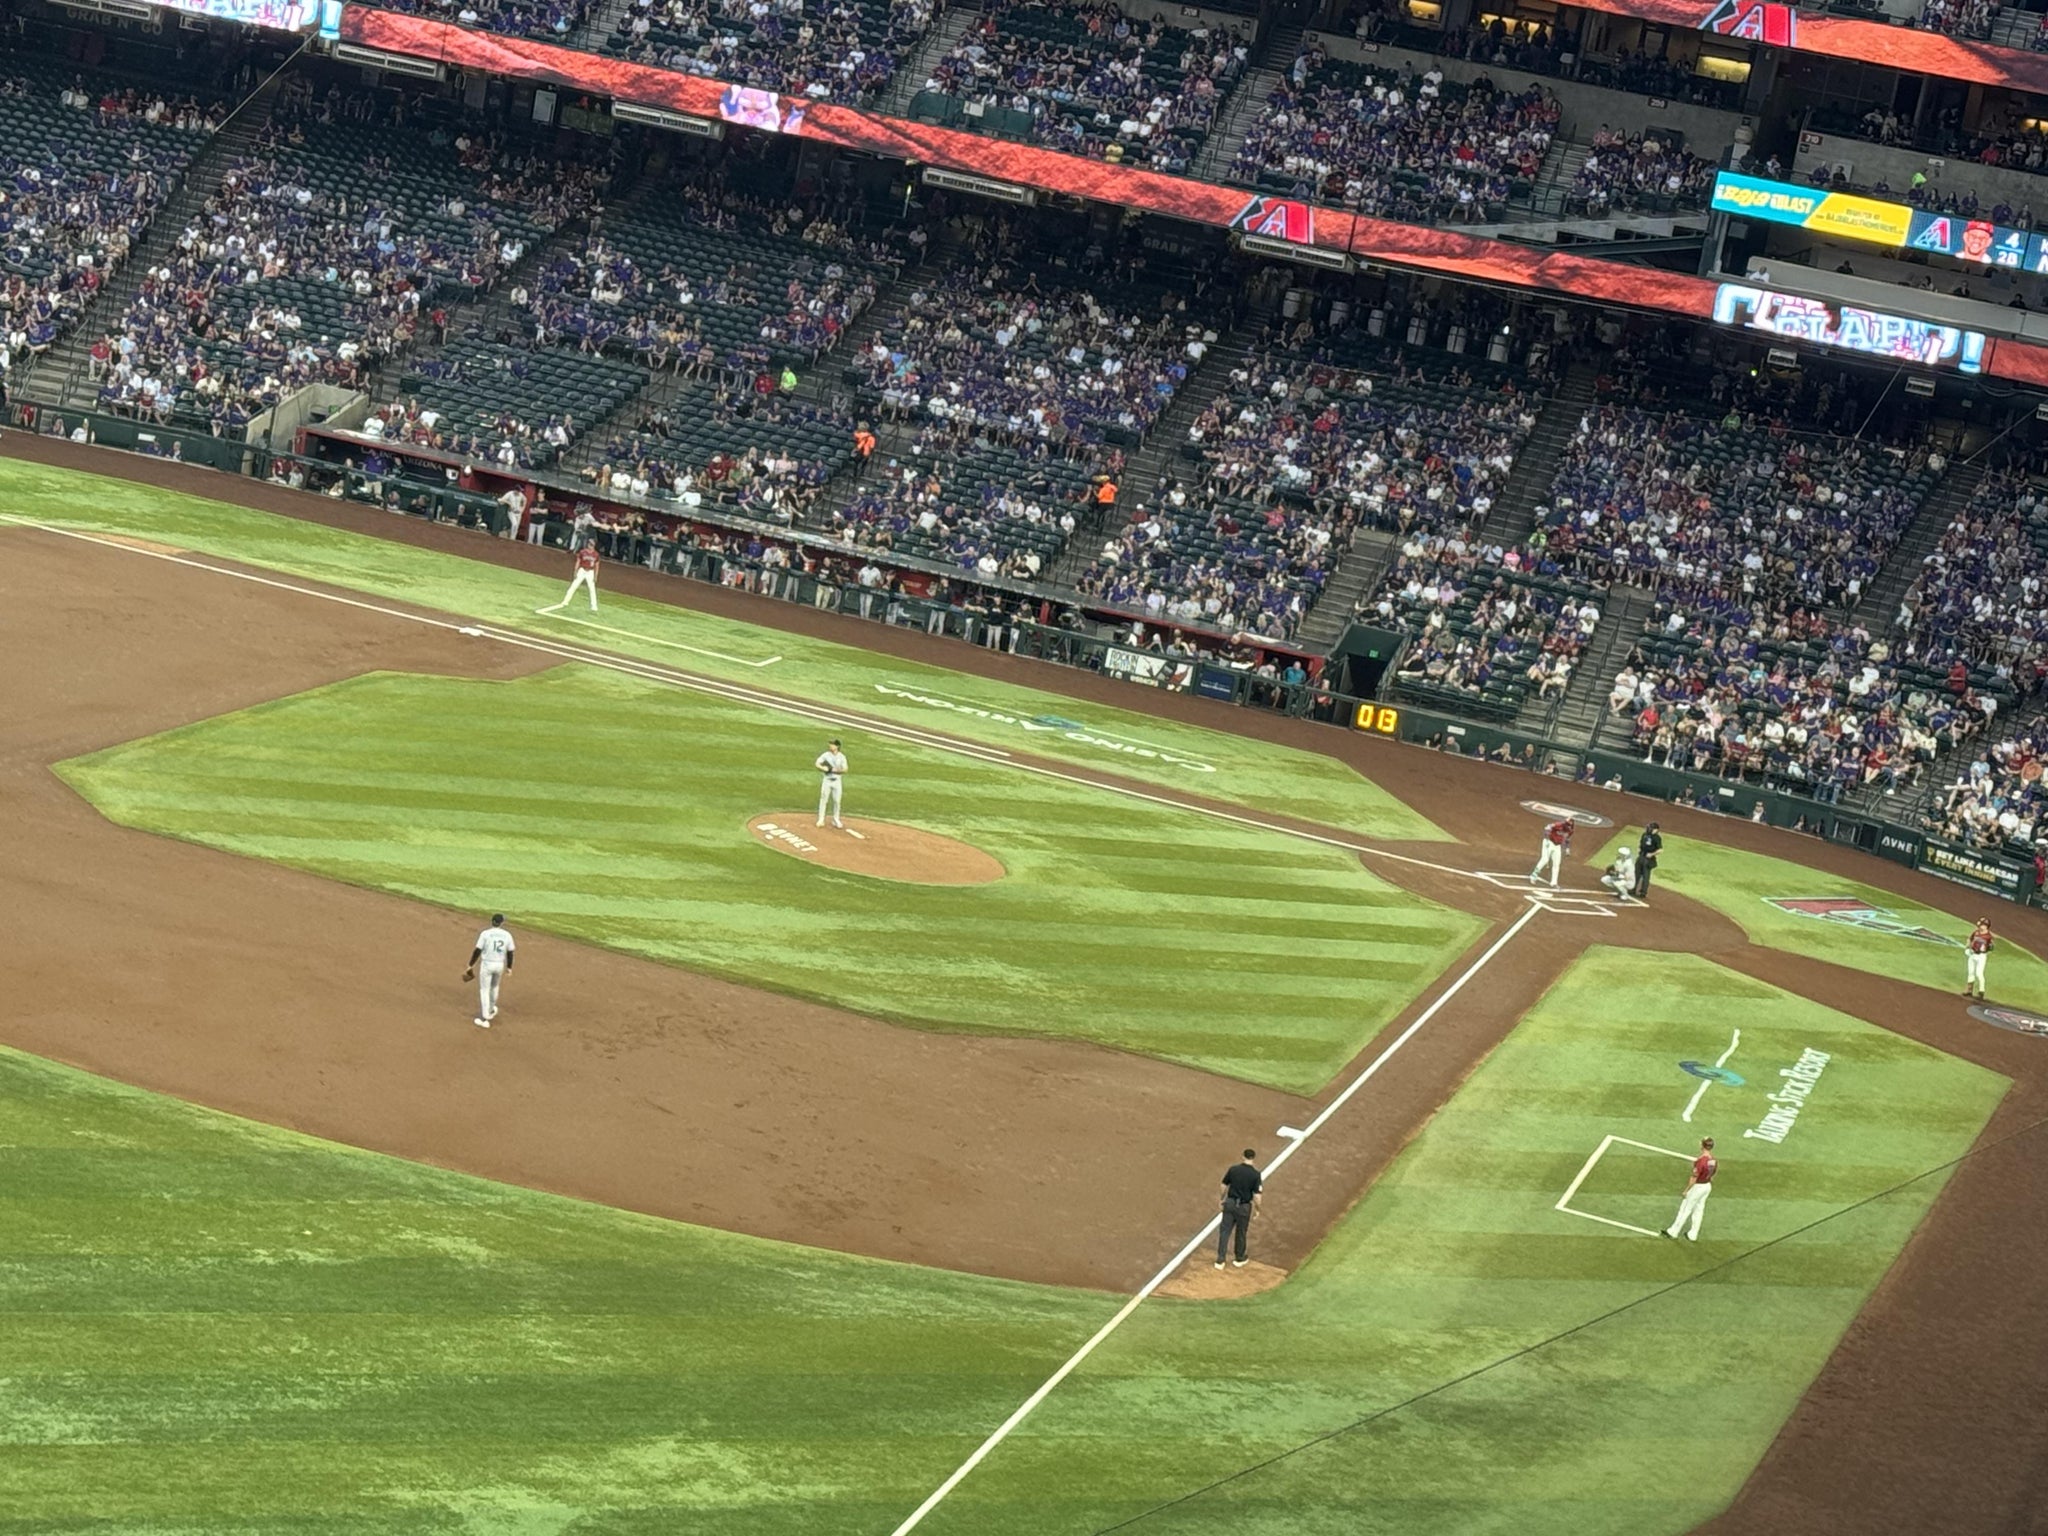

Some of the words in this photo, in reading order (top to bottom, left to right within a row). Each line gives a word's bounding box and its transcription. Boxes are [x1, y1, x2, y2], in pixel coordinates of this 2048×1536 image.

[67, 7, 112, 25] GRAB
[141, 20, 163, 36] GO
[1143, 237, 1179, 253] GRAB
[2005, 232, 2020, 248] 4
[874, 684, 1055, 731] ARIZONA
[1065, 731, 1217, 773] CASINO
[1934, 858, 1963, 871] EVERY
[1964, 865, 1997, 882] INNING
[1936, 849, 1954, 861] BET
[1954, 855, 1976, 868] LIKE
[1975, 862, 1982, 871] A
[1983, 865, 2019, 882] CAESAR
[493, 939, 505, 953] 12
